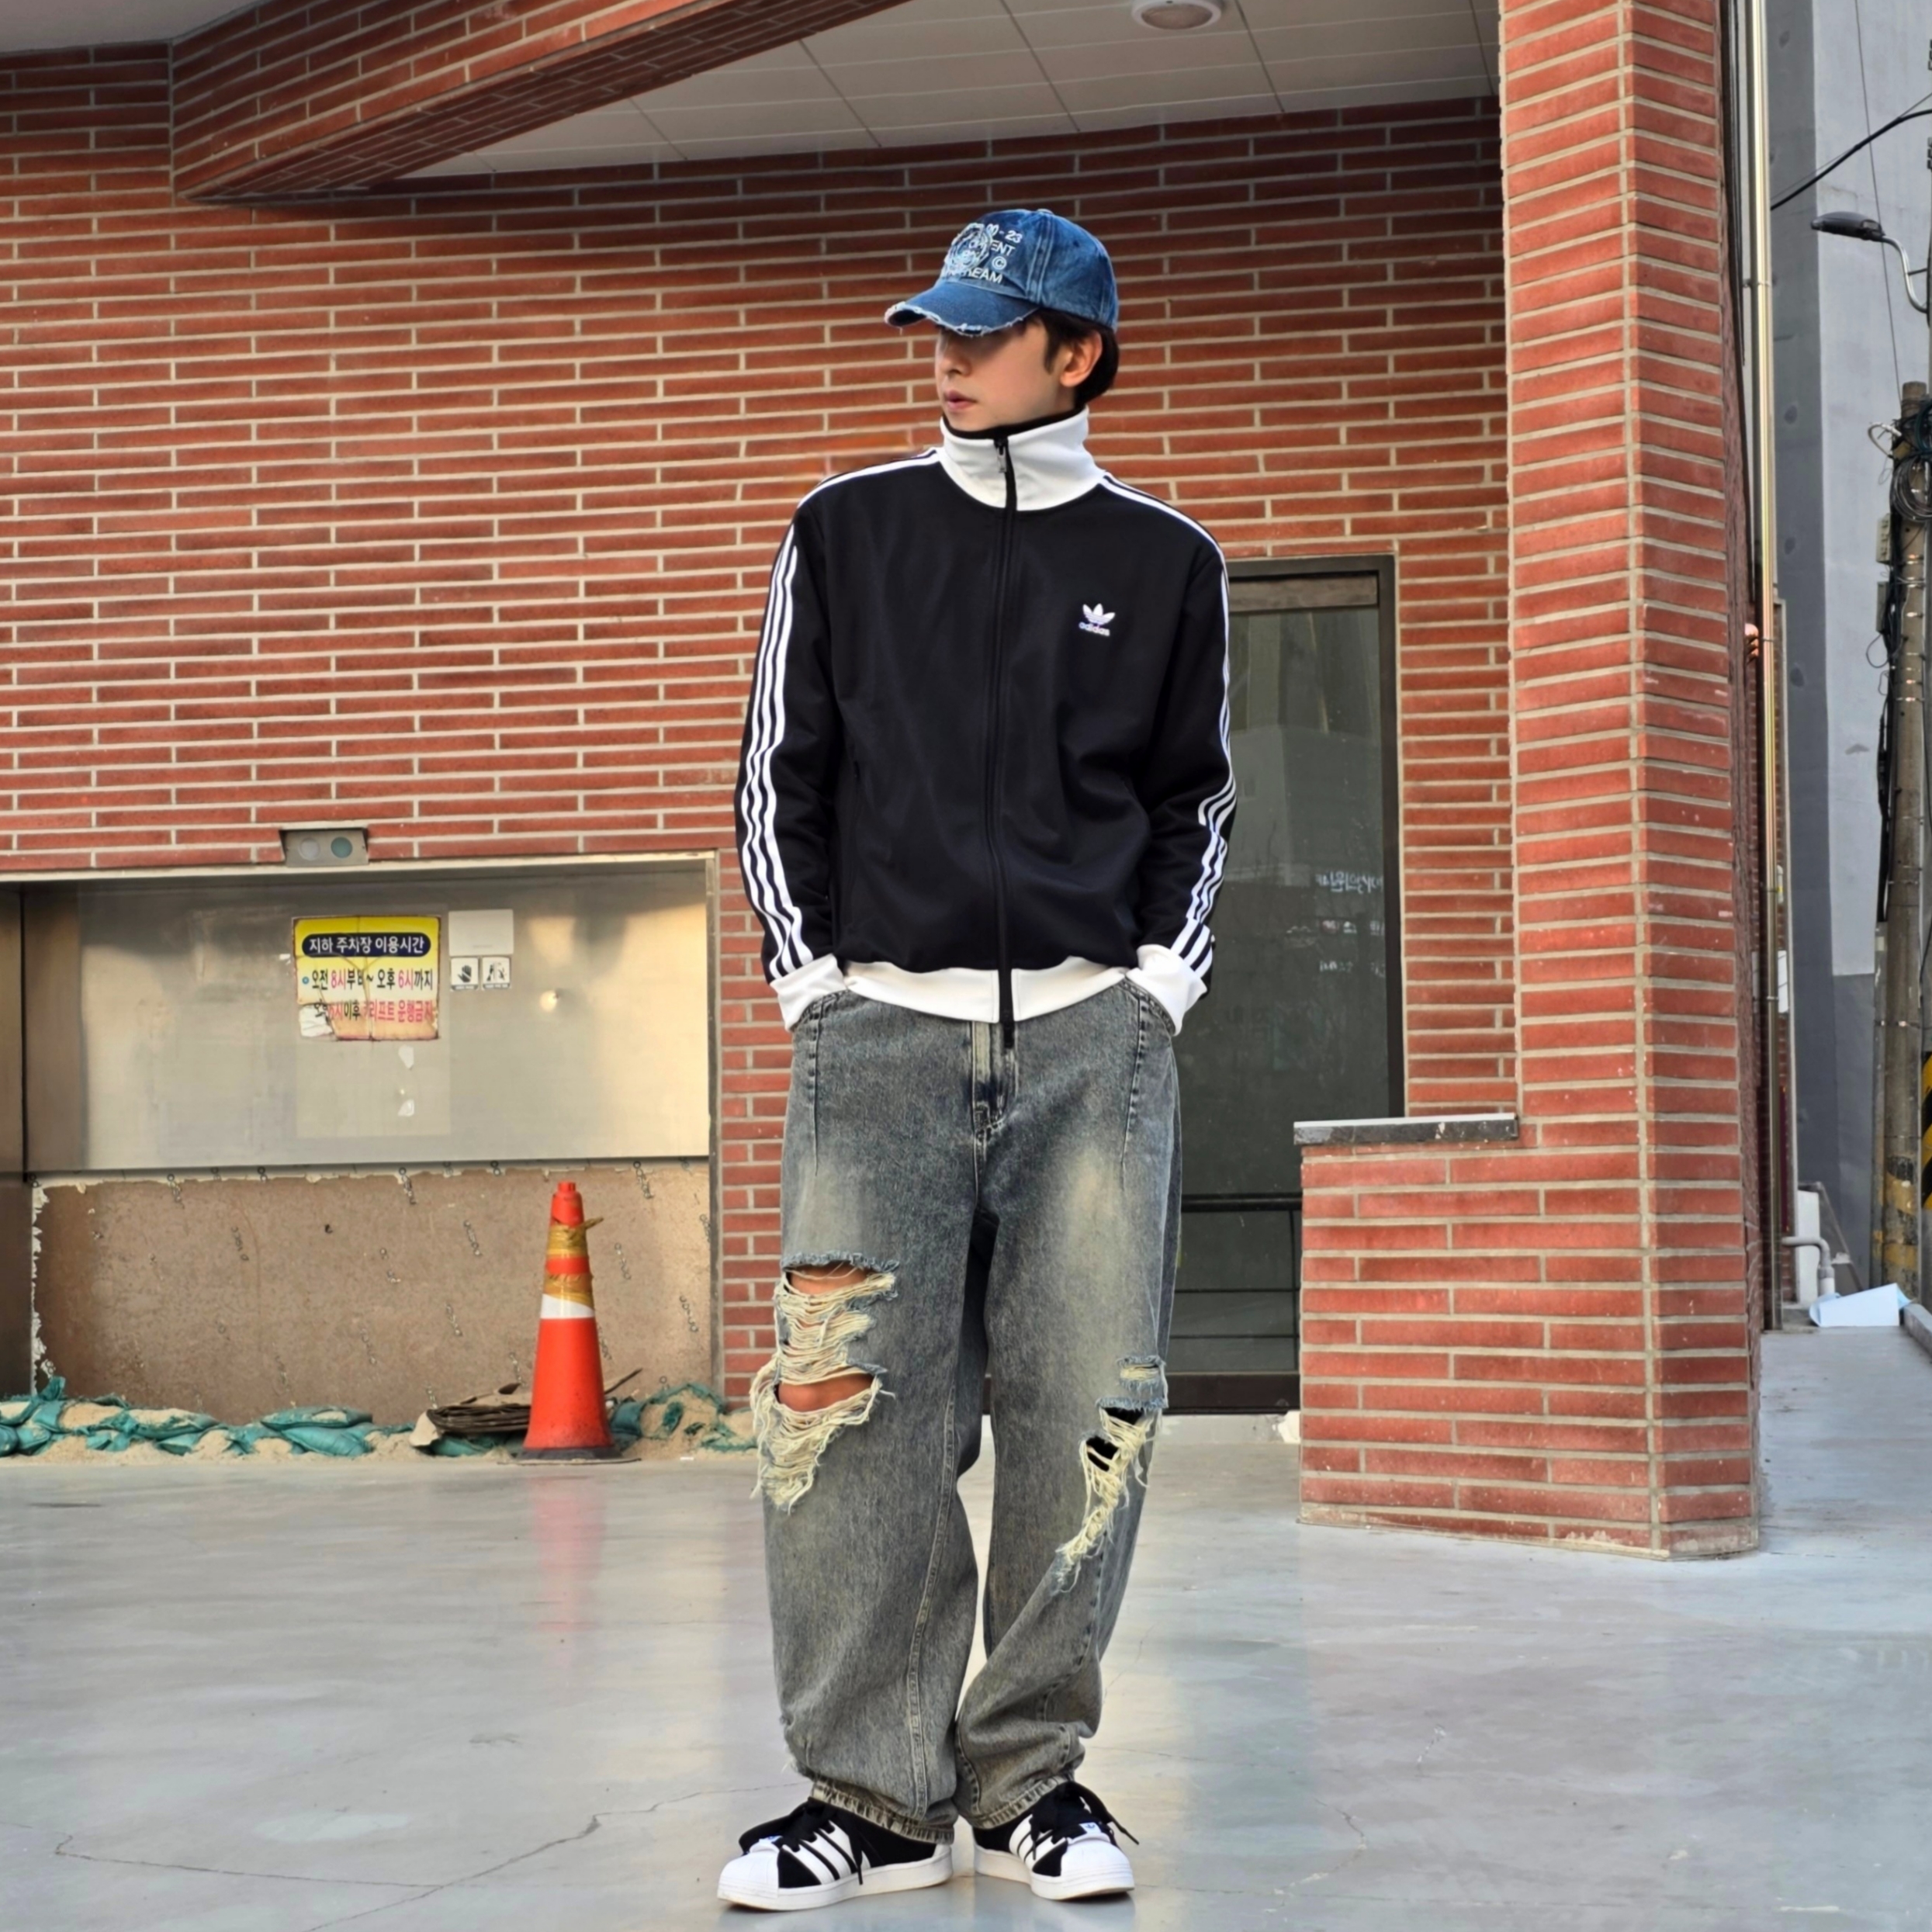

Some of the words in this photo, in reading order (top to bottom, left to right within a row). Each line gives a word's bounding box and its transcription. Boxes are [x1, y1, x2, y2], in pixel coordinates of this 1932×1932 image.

[309, 937, 334, 954] 지하
[336, 937, 372, 954] 주차장
[375, 936, 425, 954] 이용시간
[312, 968, 328, 990] 오전
[376, 968, 395, 990] 오후
[398, 968, 433, 991] 6시까지
